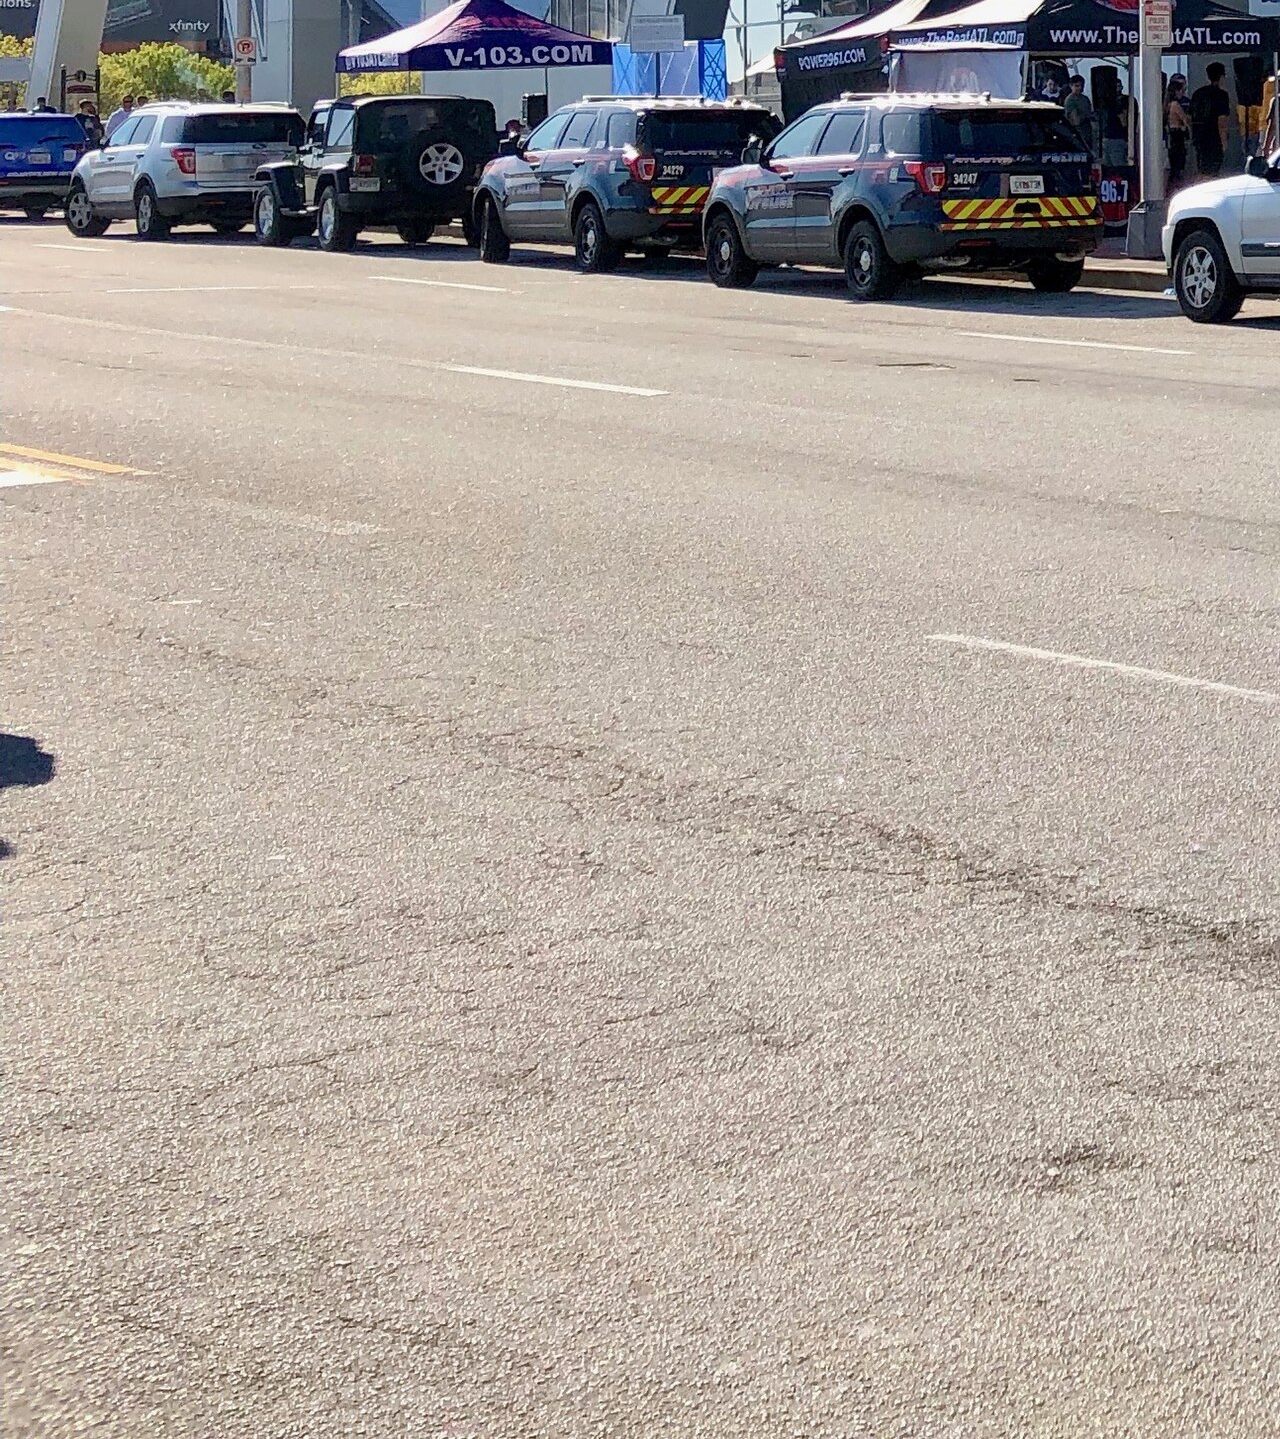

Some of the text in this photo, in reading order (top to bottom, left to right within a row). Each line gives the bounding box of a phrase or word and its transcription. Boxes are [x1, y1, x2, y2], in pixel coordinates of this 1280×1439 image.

[168, 19, 210, 33] xfinity
[444, 44, 593, 67] V-103.COM
[798, 47, 866, 71] POWER961.COM
[953, 173, 978, 185] 34247
[1101, 180, 1129, 202] 96.7
